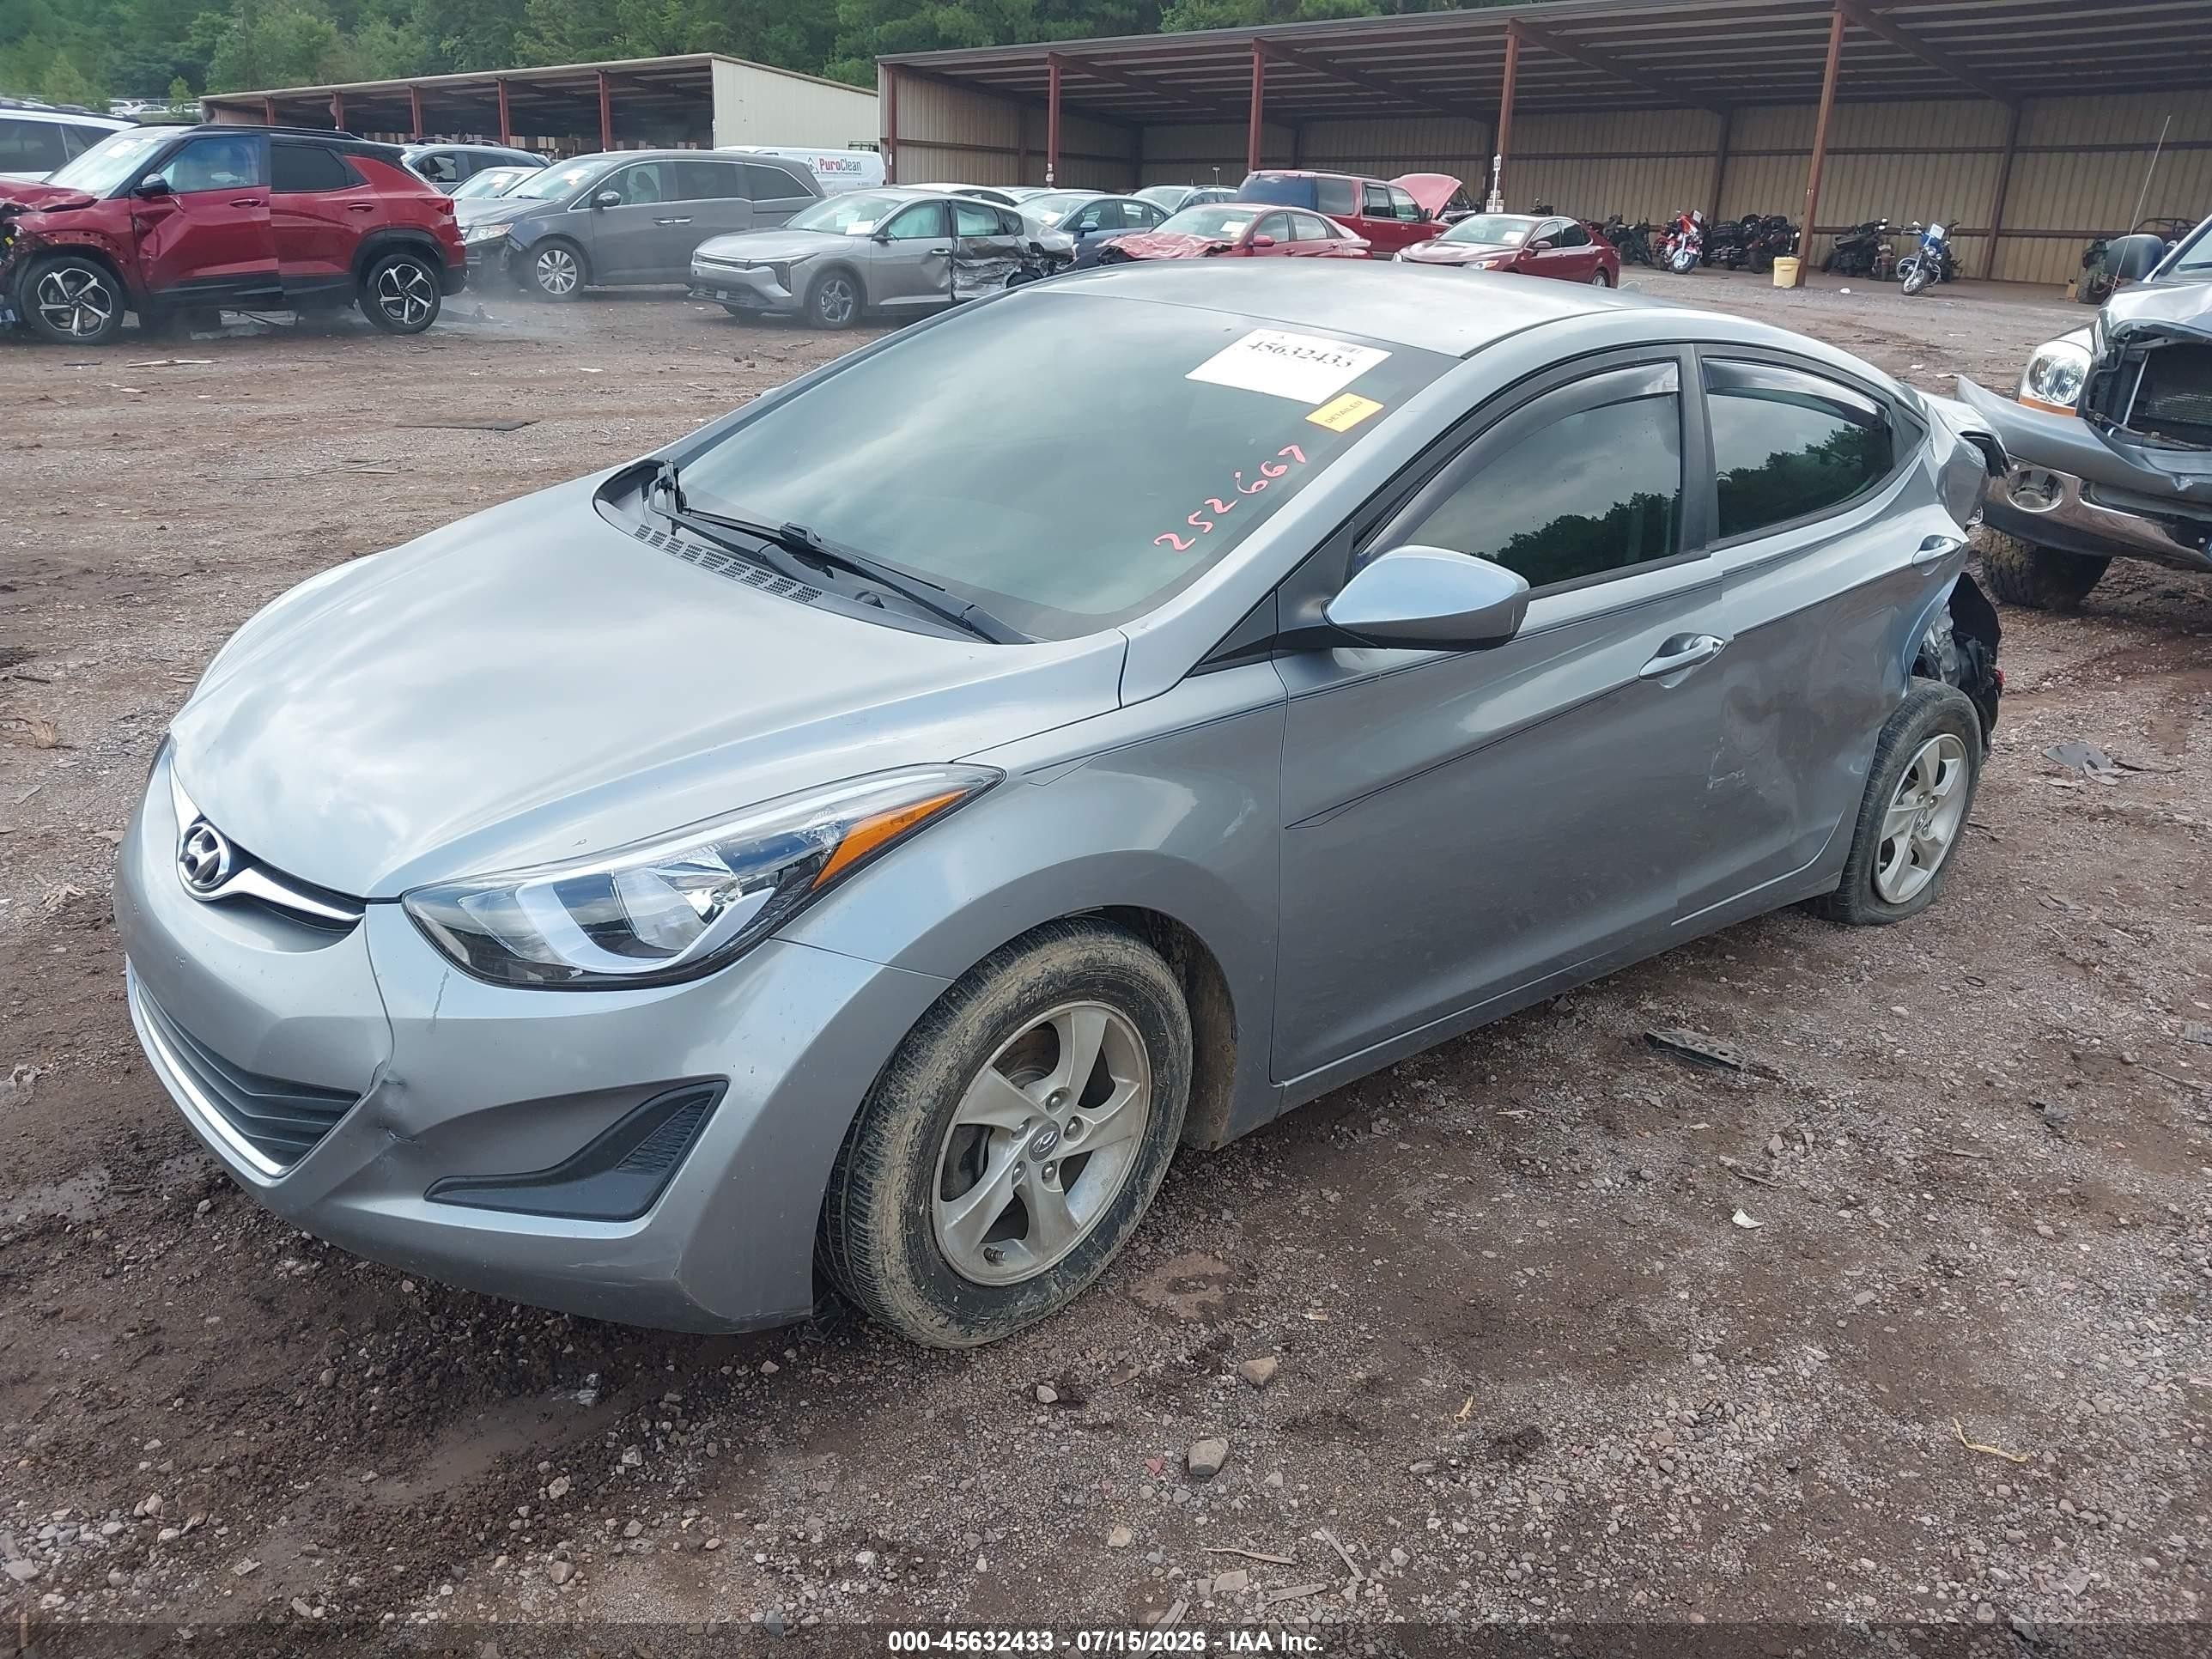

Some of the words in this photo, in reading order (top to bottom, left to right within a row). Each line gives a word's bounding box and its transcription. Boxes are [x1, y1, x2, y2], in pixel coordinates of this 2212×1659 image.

[818, 157, 862, 172] PuroClean
[1247, 341, 1356, 368] 45632433
[1324, 400, 1364, 424] DETAILED
